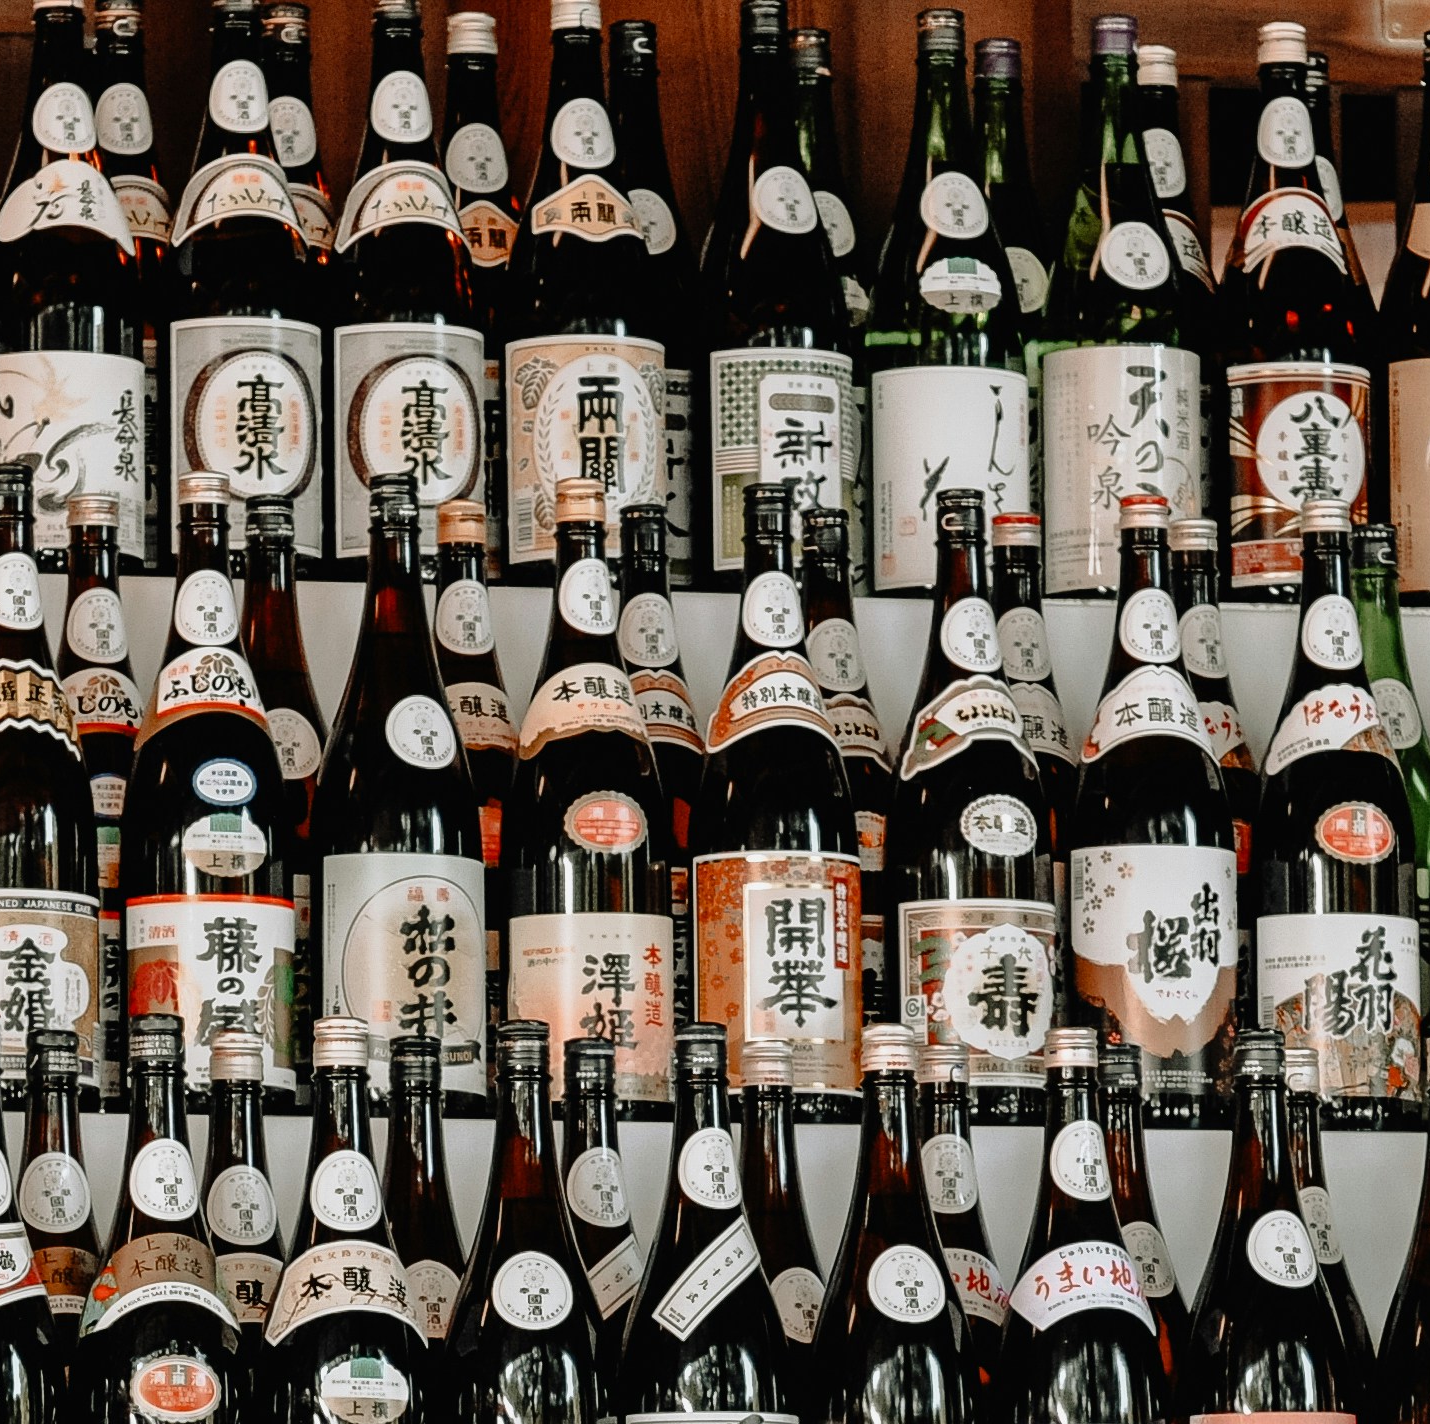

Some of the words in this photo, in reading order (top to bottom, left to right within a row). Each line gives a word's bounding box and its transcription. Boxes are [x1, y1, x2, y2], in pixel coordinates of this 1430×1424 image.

[112, 390, 138, 484] 長命泉
[1087, 414, 1131, 506] 吟泉
[553, 675, 633, 706] 本醸造
[1115, 696, 1200, 733] 本醸造
[206, 852, 246, 870] 上撰
[23, 900, 73, 912] JAPANESE
[833, 880, 850, 969] 特別本醸造
[1189, 882, 1224, 968] 出羽
[399, 906, 456, 1038] 松の井
[759, 898, 836, 1028] 開華
[979, 947, 1033, 962] 千代
[581, 952, 637, 1050] 澤姫
[643, 944, 665, 1028] 本醸造
[1304, 971, 1356, 1040] 陽
[129, 1255, 205, 1279] 本醸造
[141, 1237, 192, 1254] 上撰
[300, 1265, 407, 1308] 本醸造
[346, 1398, 389, 1418] 上撰
